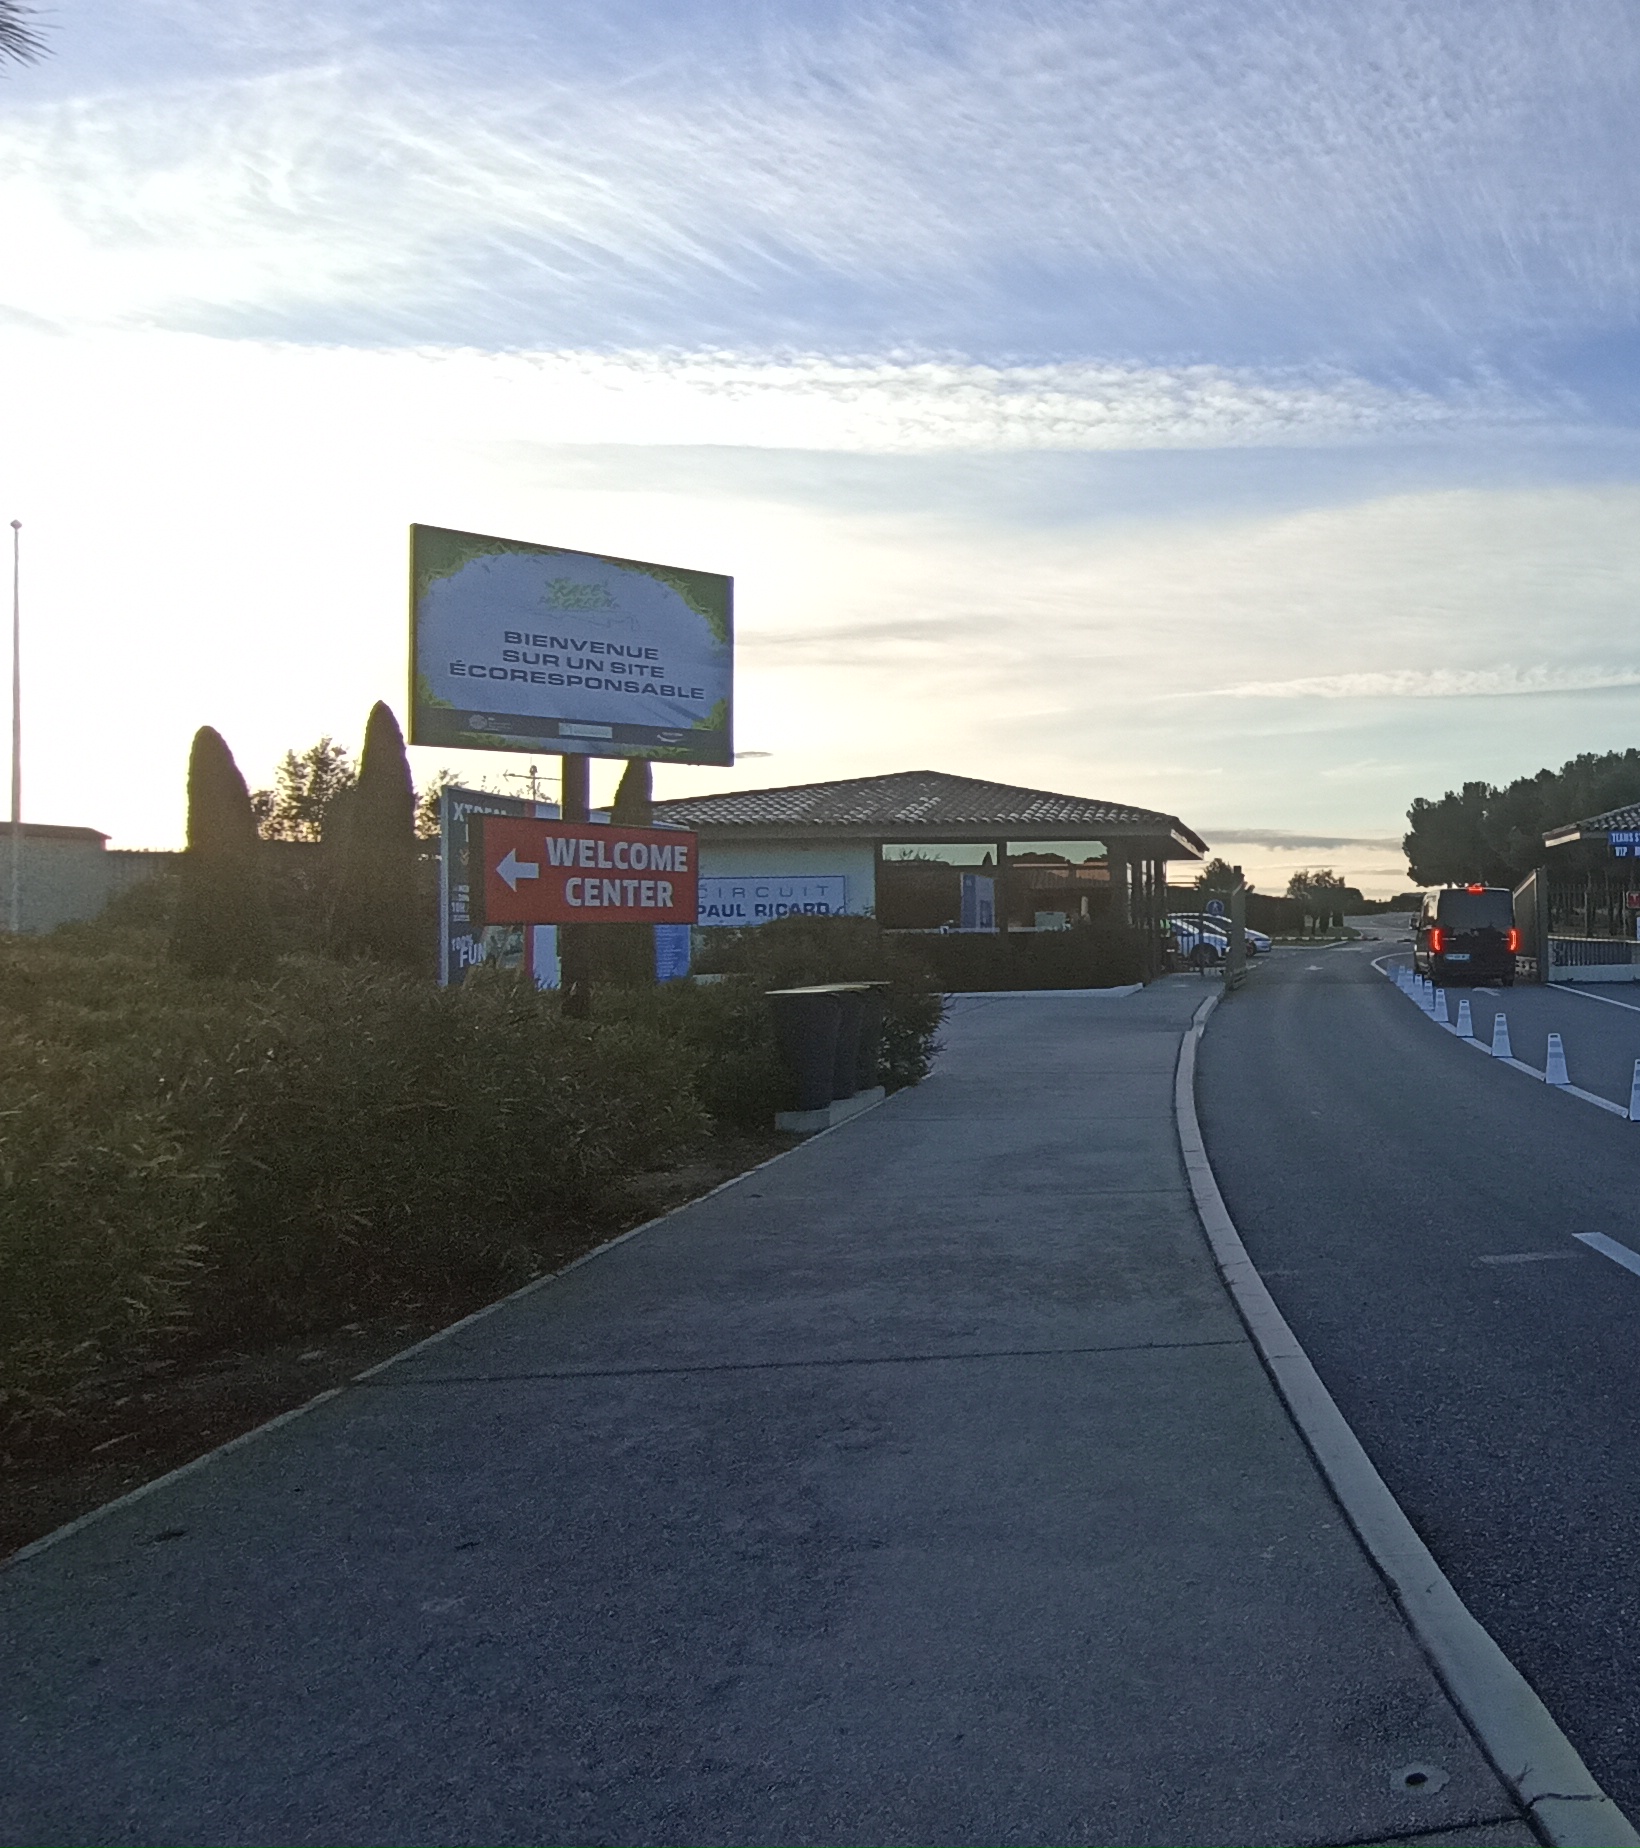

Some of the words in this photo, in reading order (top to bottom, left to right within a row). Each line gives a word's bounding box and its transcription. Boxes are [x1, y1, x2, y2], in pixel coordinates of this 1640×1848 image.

[504, 631, 659, 661] BIENVENUE
[502, 650, 560, 668] SUR
[566, 656, 604, 672] UN
[610, 661, 665, 679] SITE
[449, 660, 705, 700] ÉCORESPONSABLE
[1611, 832, 1633, 843] TEAMS
[1615, 846, 1628, 857] VIP
[545, 836, 689, 872] WELCOME
[565, 877, 674, 908] CENTER
[754, 902, 830, 917] RICARD
[460, 941, 487, 968] FUN
